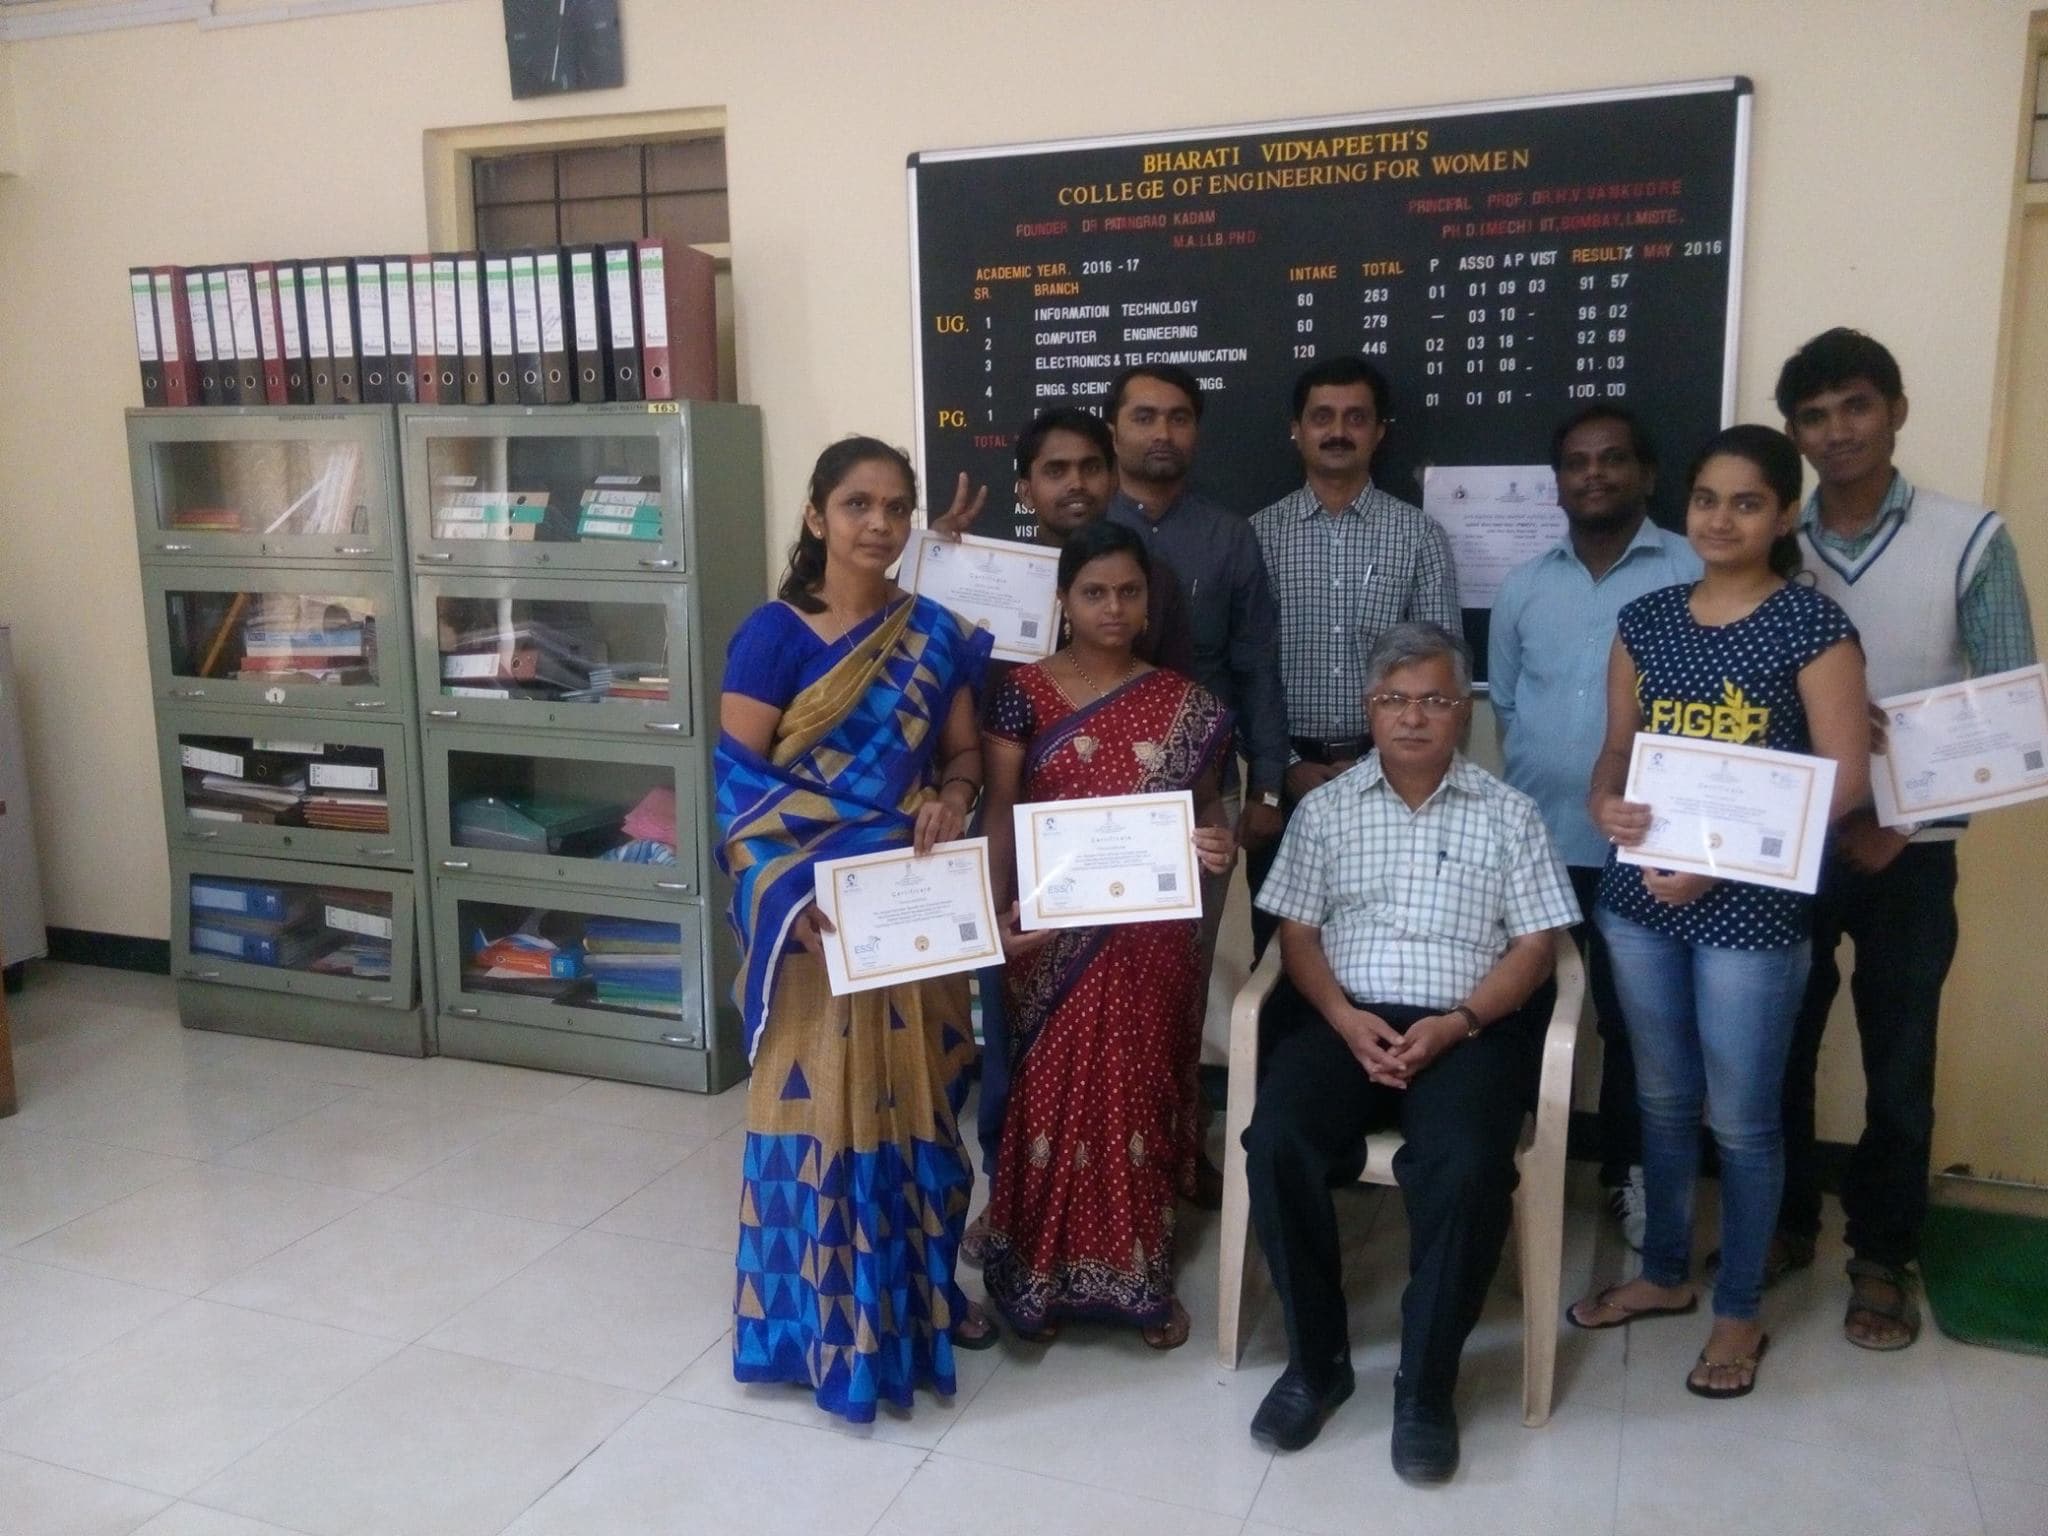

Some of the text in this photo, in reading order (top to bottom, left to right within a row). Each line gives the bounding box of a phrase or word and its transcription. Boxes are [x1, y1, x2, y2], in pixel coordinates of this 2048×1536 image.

[1143, 130, 1429, 173] BHARATI VIDYAPEETH'S
[1058, 149, 1530, 205] COLLEGE OF ENGINEERING FOR WOMEN
[1016, 221, 1068, 237] FOUNDER
[1173, 210, 1216, 226] KADAM
[976, 265, 1032, 281] ACADEMIC
[1082, 261, 1112, 275] 2016
[1034, 282, 1080, 296] BRANCH
[1290, 265, 1337, 281] INTAKE
[1362, 262, 1404, 277] TOTAL
[1430, 258, 1440, 272] P
[1459, 255, 1495, 271] ASSO
[1530, 250, 1558, 267] VIST
[1684, 240, 1723, 256] 2016
[936, 315, 969, 333] UG.
[985, 317, 991, 329] 1
[1035, 305, 1110, 321] INFORMATION
[1122, 300, 1198, 316] TECHNOLOGY
[1297, 293, 1314, 307] 60
[1364, 288, 1388, 303] 263
[1428, 285, 1445, 299] 01
[1469, 283, 1486, 297] 01
[1499, 281, 1516, 295] 09
[1528, 279, 1545, 293] 03
[985, 338, 992, 350] 2
[1035, 330, 1097, 345] COMPUTER
[1124, 325, 1198, 342] ENGINEERING
[1297, 319, 1313, 333] 60
[1363, 315, 1388, 329] 279
[1468, 309, 1486, 323] 03
[1500, 307, 1515, 321] 10
[985, 360, 992, 372] 3
[1036, 354, 1111, 370] ELECTRONICS
[1113, 353, 1121, 366] &
[1293, 344, 1315, 358] 120
[1362, 341, 1387, 355] 446
[1426, 338, 1444, 352] 02
[1467, 336, 1485, 350] 03
[1499, 334, 1514, 348] 18
[985, 386, 992, 398] 4
[1036, 383, 1068, 396] ENGG.
[1072, 381, 1112, 395] SCIENC
[1427, 361, 1443, 375] 01
[1467, 359, 1484, 373] 01
[1499, 357, 1516, 371] 08
[653, 403, 676, 412] 163
[939, 411, 967, 428] PG.
[987, 409, 993, 422] 1
[1426, 393, 1440, 407] 01
[1466, 391, 1482, 405] 01
[1498, 390, 1512, 403] 01
[975, 435, 1008, 448] TOTAL
